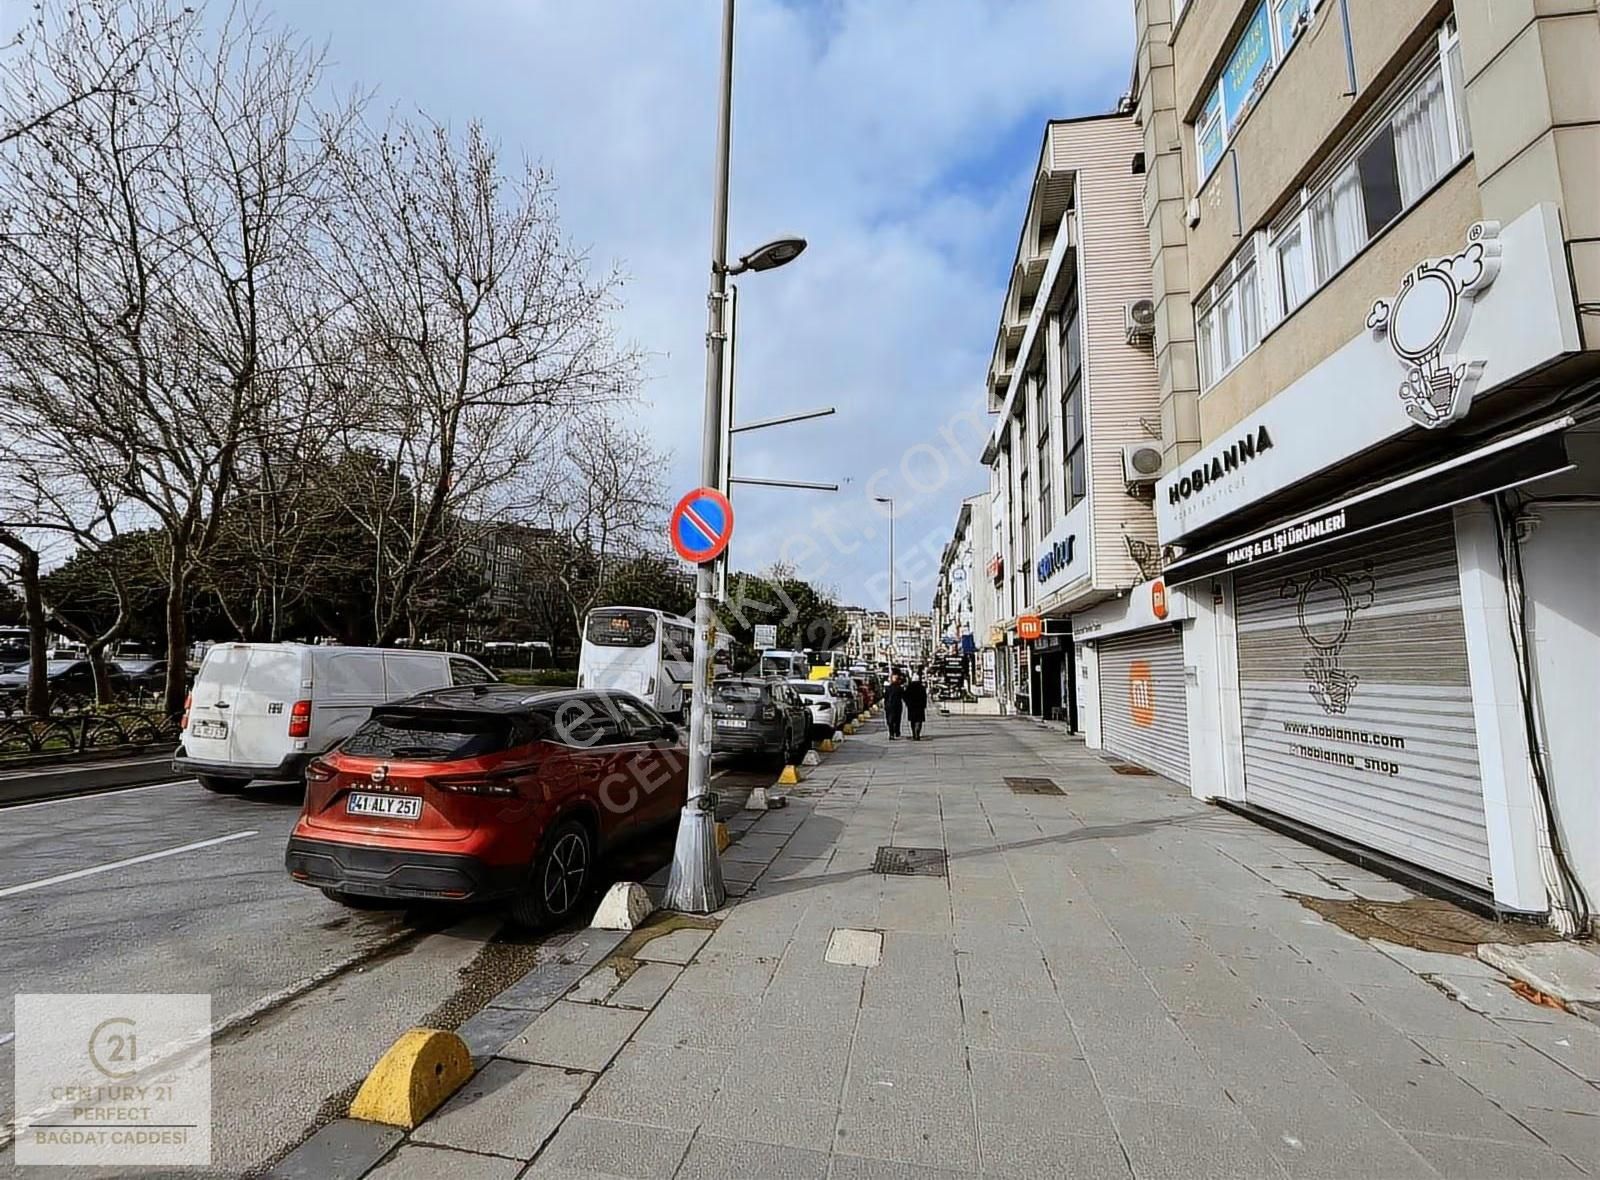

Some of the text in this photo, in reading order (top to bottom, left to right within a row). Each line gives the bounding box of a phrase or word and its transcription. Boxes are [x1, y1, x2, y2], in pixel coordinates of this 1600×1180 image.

[1169, 425, 1275, 505] HOBIANNA
[1262, 538, 1274, 554] EL
[1288, 509, 1346, 545] ÜRÜNLERİ
[1022, 622, 1037, 633] mi
[356, 797, 417, 815] 41 ALY 251
